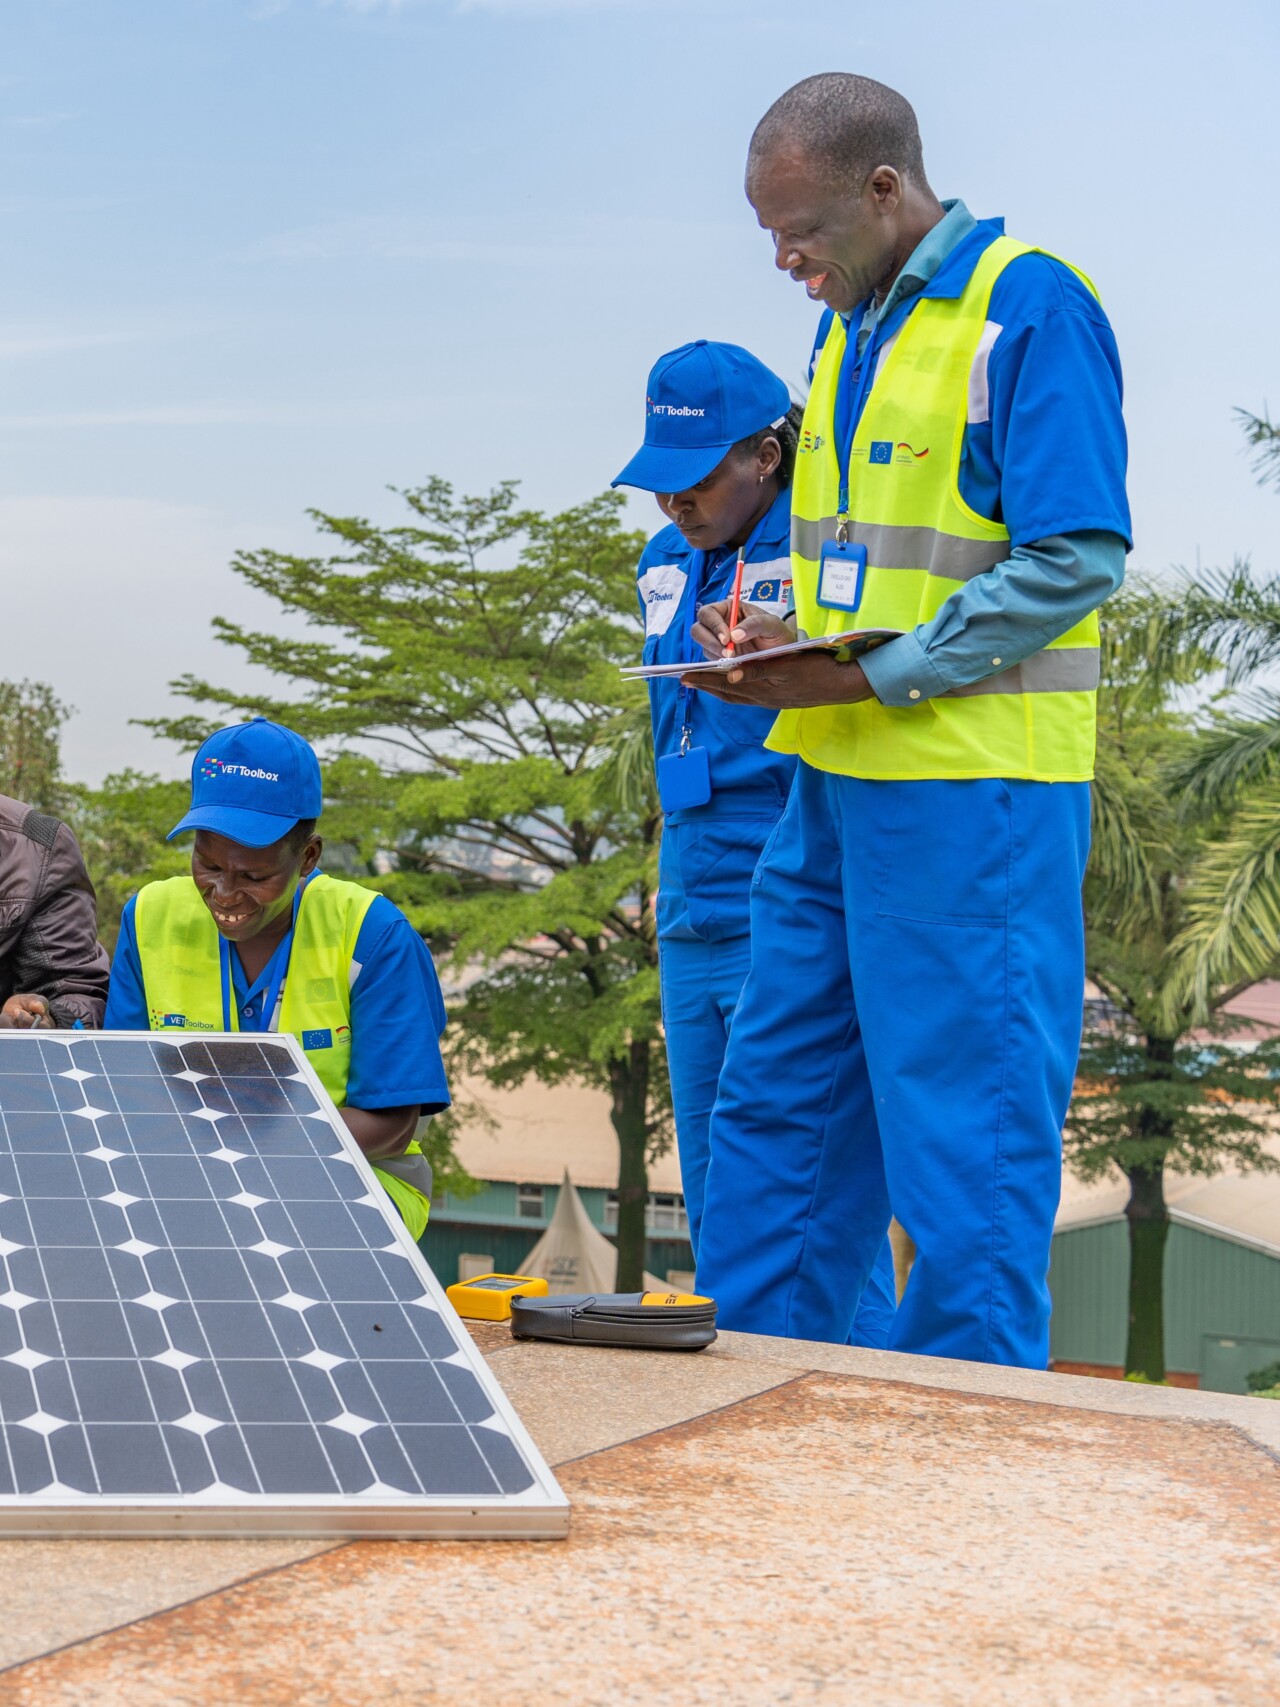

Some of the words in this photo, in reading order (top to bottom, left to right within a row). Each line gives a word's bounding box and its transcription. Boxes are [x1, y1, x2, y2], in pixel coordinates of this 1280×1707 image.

[652, 404, 666, 415] VET
[666, 405, 705, 417] Toolbox
[221, 764, 239, 774] VET
[239, 765, 279, 782] Toolbox
[170, 1016, 185, 1026] VET
[185, 1018, 215, 1029] Toolbox
